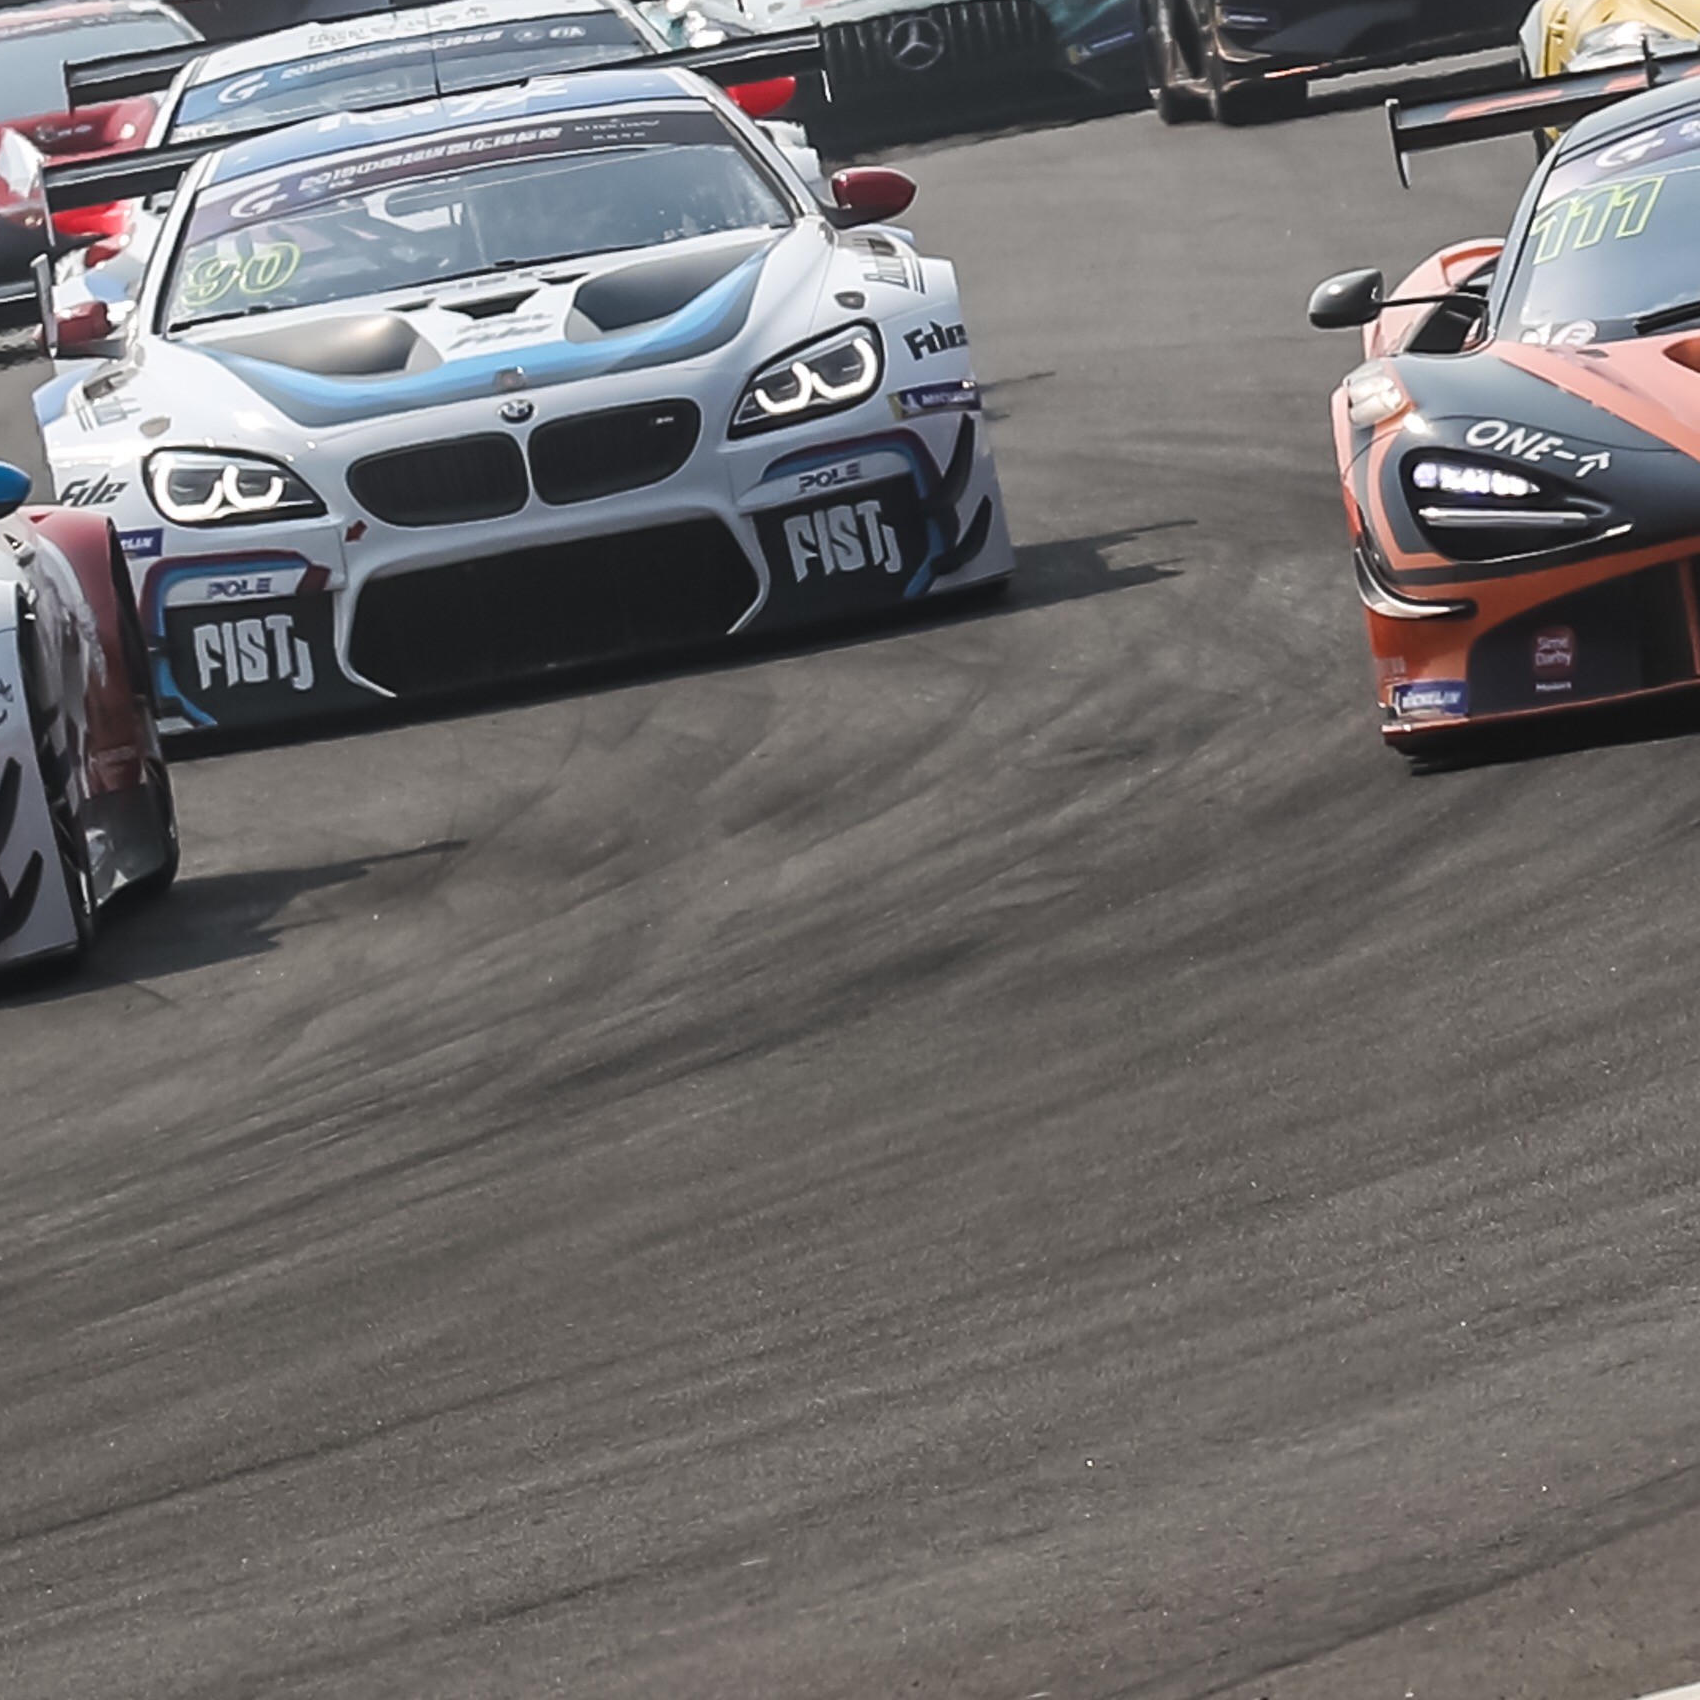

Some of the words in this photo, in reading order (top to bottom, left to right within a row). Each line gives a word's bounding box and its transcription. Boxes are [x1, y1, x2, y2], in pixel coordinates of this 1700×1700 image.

[1529, 175, 1667, 266] 111
[181, 241, 301, 307] 90
[798, 462, 862, 493] POLE
[206, 576, 273, 598] POLE
